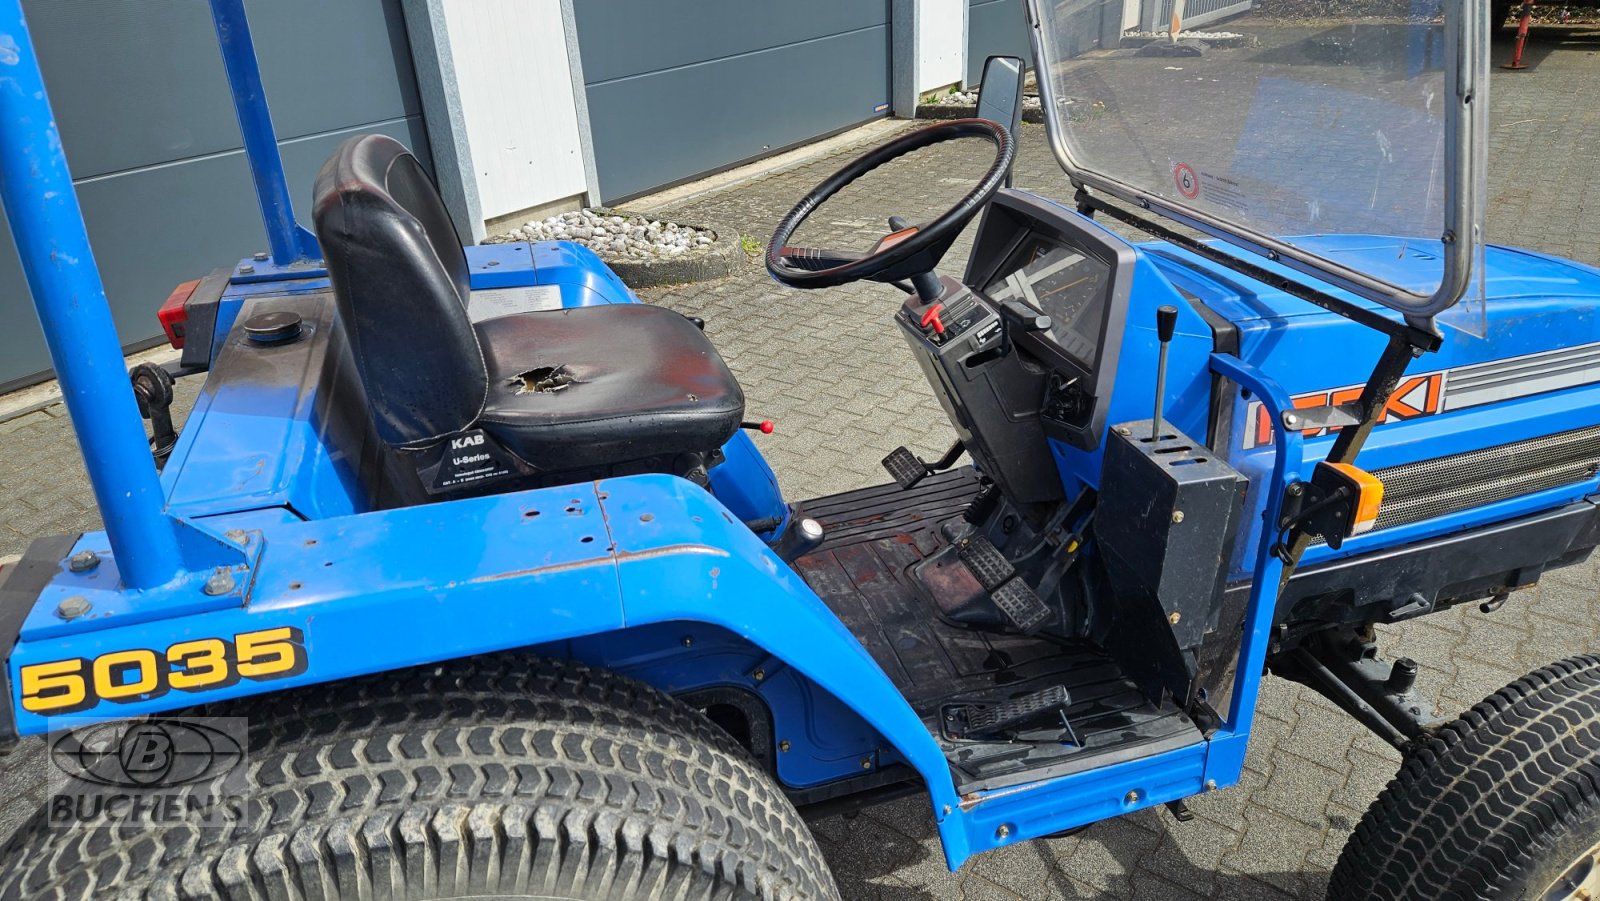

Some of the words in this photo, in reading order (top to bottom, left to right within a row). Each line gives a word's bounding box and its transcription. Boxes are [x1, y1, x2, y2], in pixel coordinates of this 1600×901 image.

[1183, 173, 1191, 188] 6
[451, 434, 485, 449] KAB
[453, 453, 491, 466] U-Series
[21, 627, 308, 716] 5035
